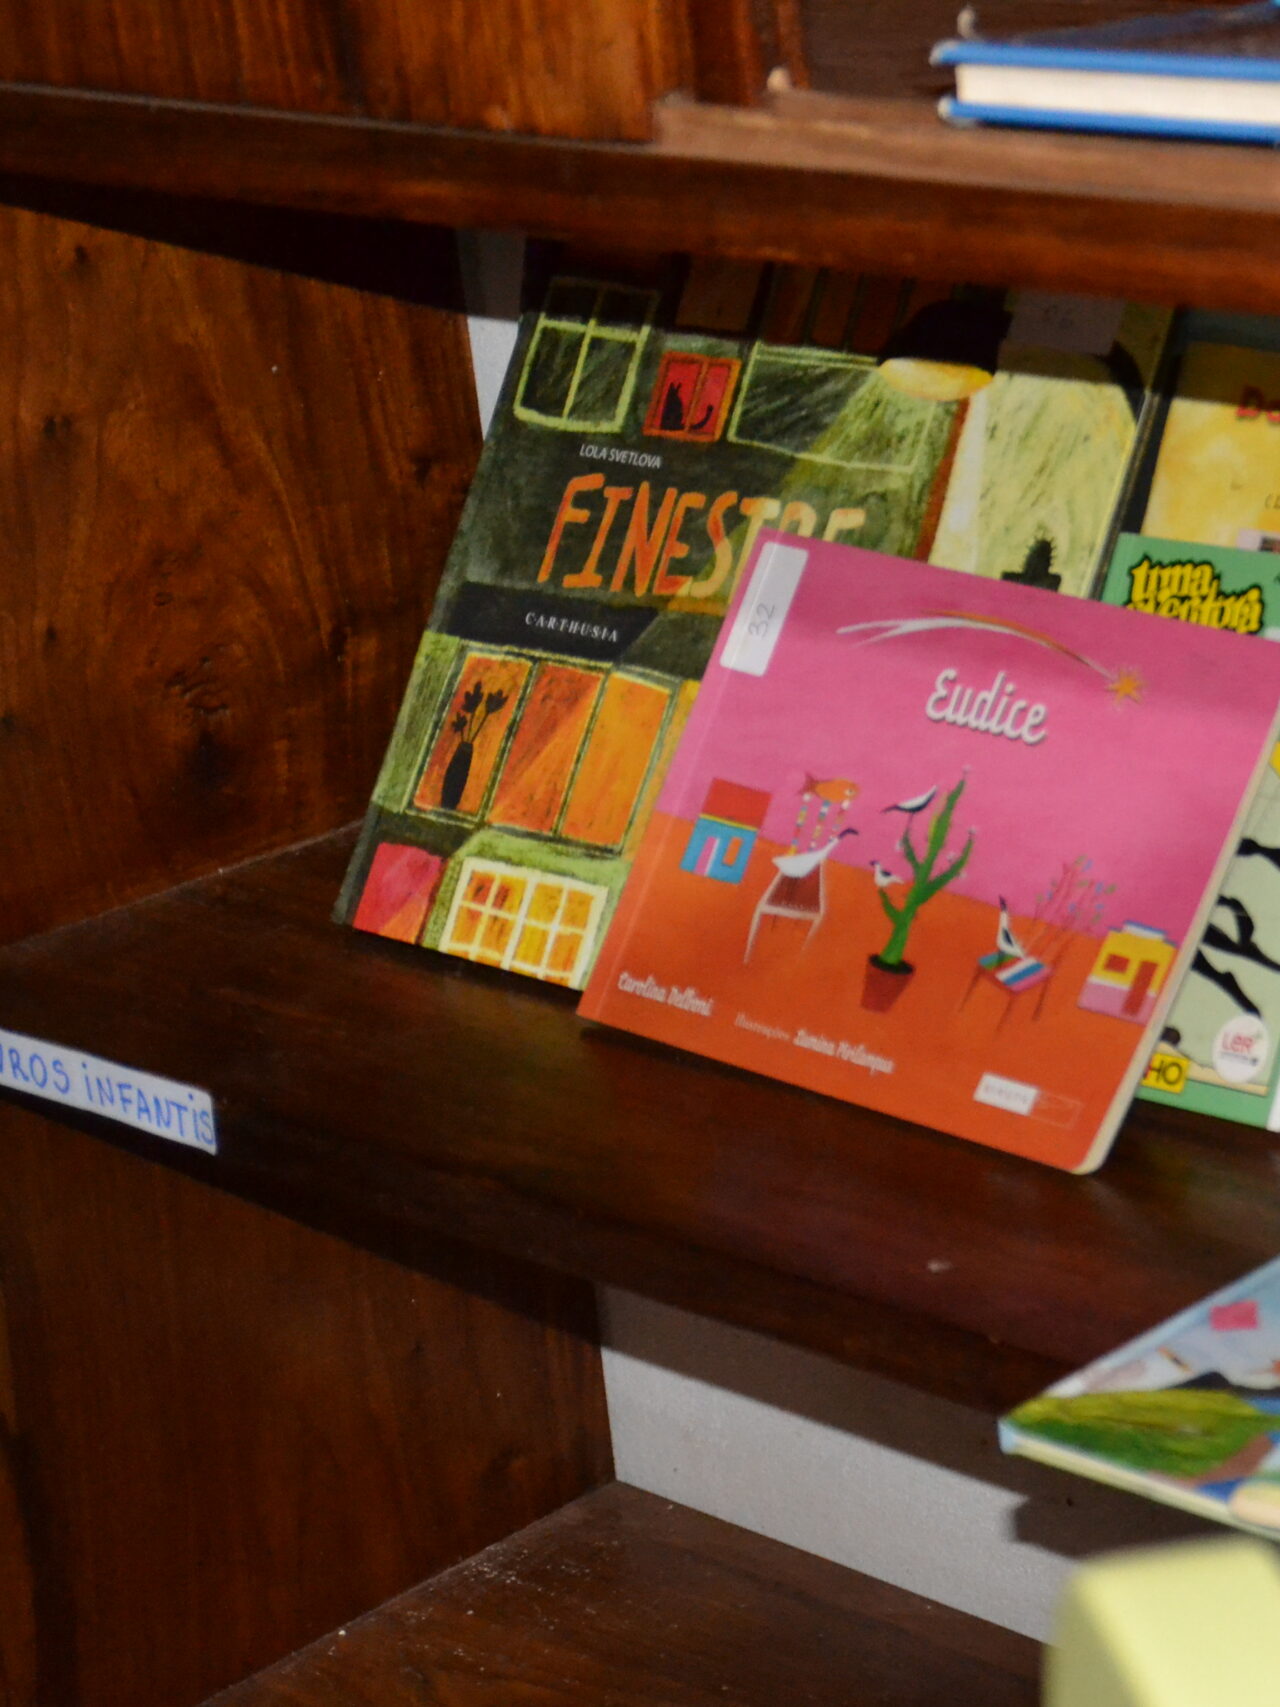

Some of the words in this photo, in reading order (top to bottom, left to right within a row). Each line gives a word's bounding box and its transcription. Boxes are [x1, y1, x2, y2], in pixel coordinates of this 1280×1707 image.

[580, 443, 608, 460] LOLA
[608, 447, 662, 469] SVETLOVA
[747, 602, 776, 639] 32
[925, 667, 1047, 744] Eudice
[0, 1043, 71, 1094] ROS
